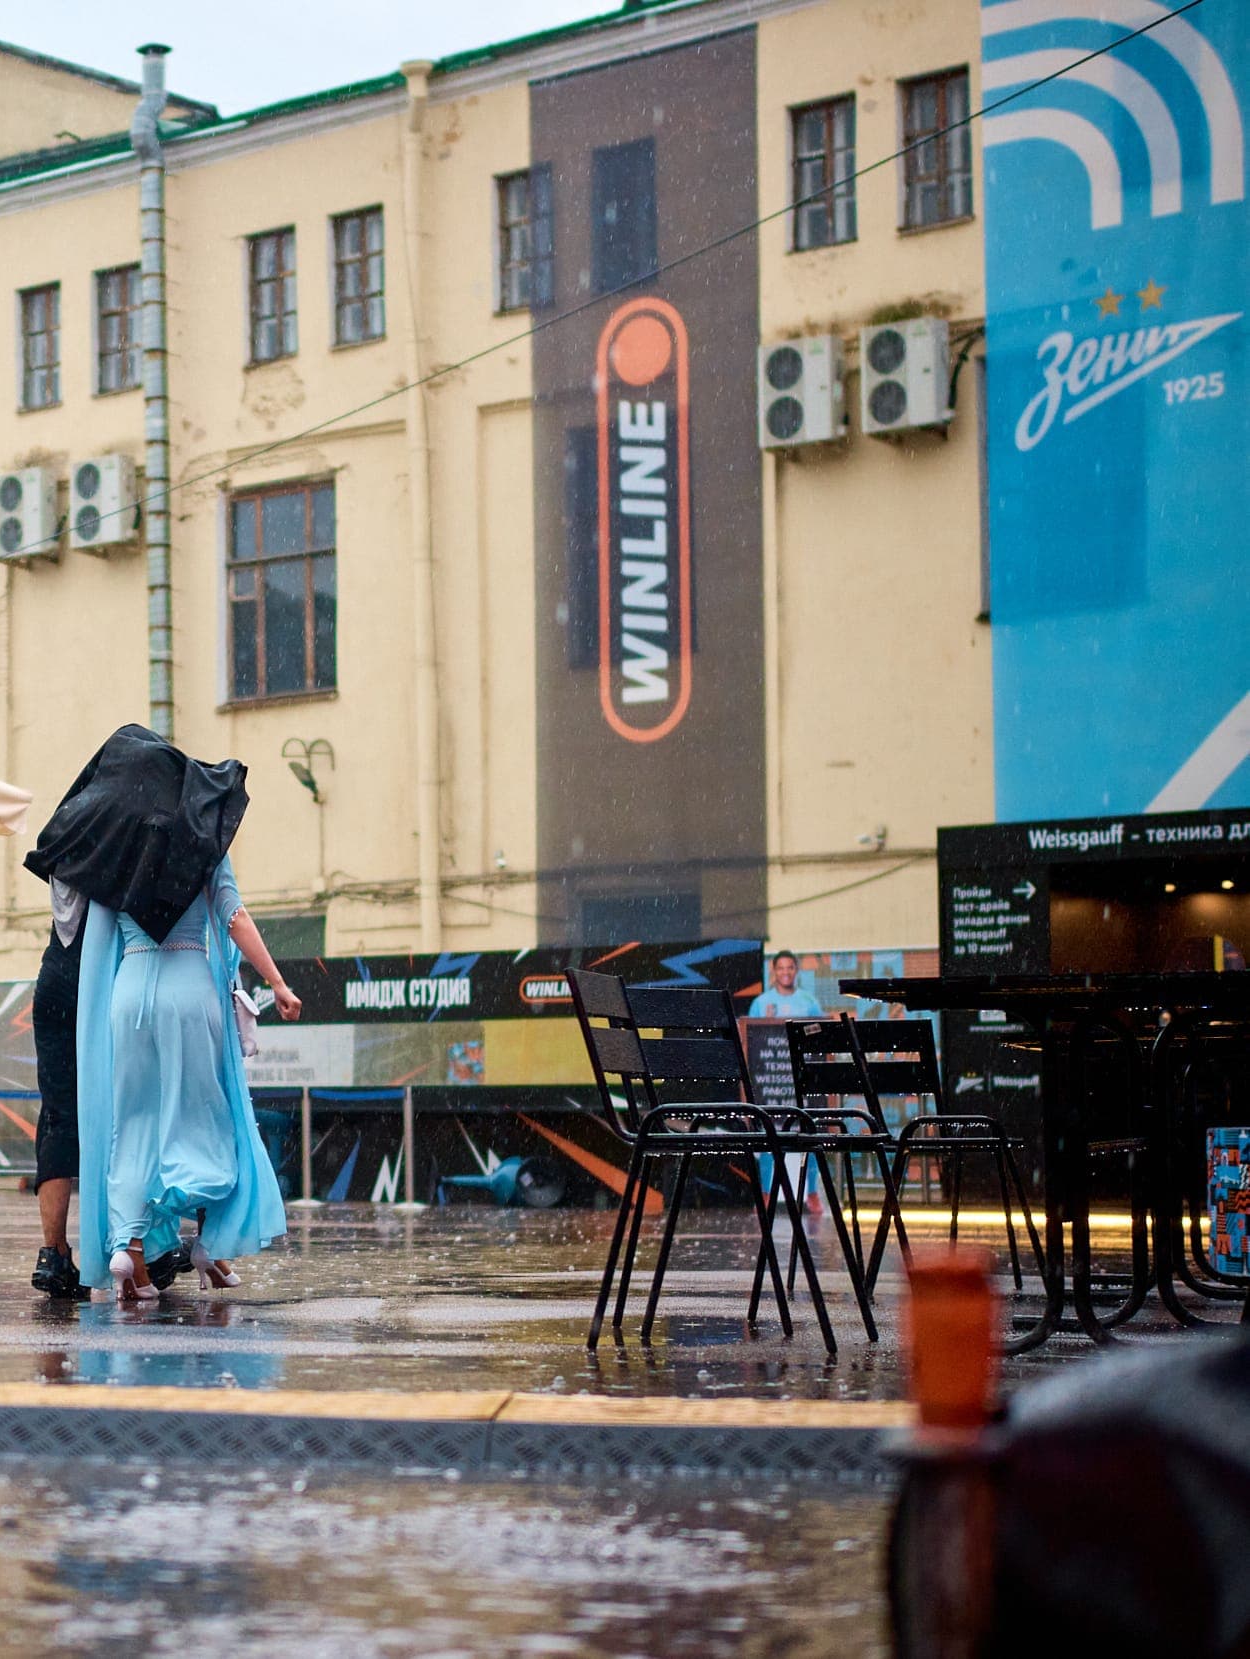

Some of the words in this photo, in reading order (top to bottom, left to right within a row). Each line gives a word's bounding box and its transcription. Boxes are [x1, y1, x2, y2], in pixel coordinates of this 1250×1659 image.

[1015, 312, 1243, 452] Зенит
[1162, 372, 1224, 405] 1925
[618, 399, 670, 705] WINLINE
[1028, 823, 1125, 850] Weissgauff
[1146, 823, 1224, 843] техника
[953, 886, 992, 900] Пройди
[954, 899, 1010, 912] тест-драйв
[954, 927, 1007, 941] Weissgauff
[967, 943, 977, 954] 10
[346, 980, 406, 1009] ИМИДЖ
[409, 977, 471, 1008] СТУДИЯ
[526, 980, 573, 998] WINLI
[755, 1074, 794, 1084] WEISSG
